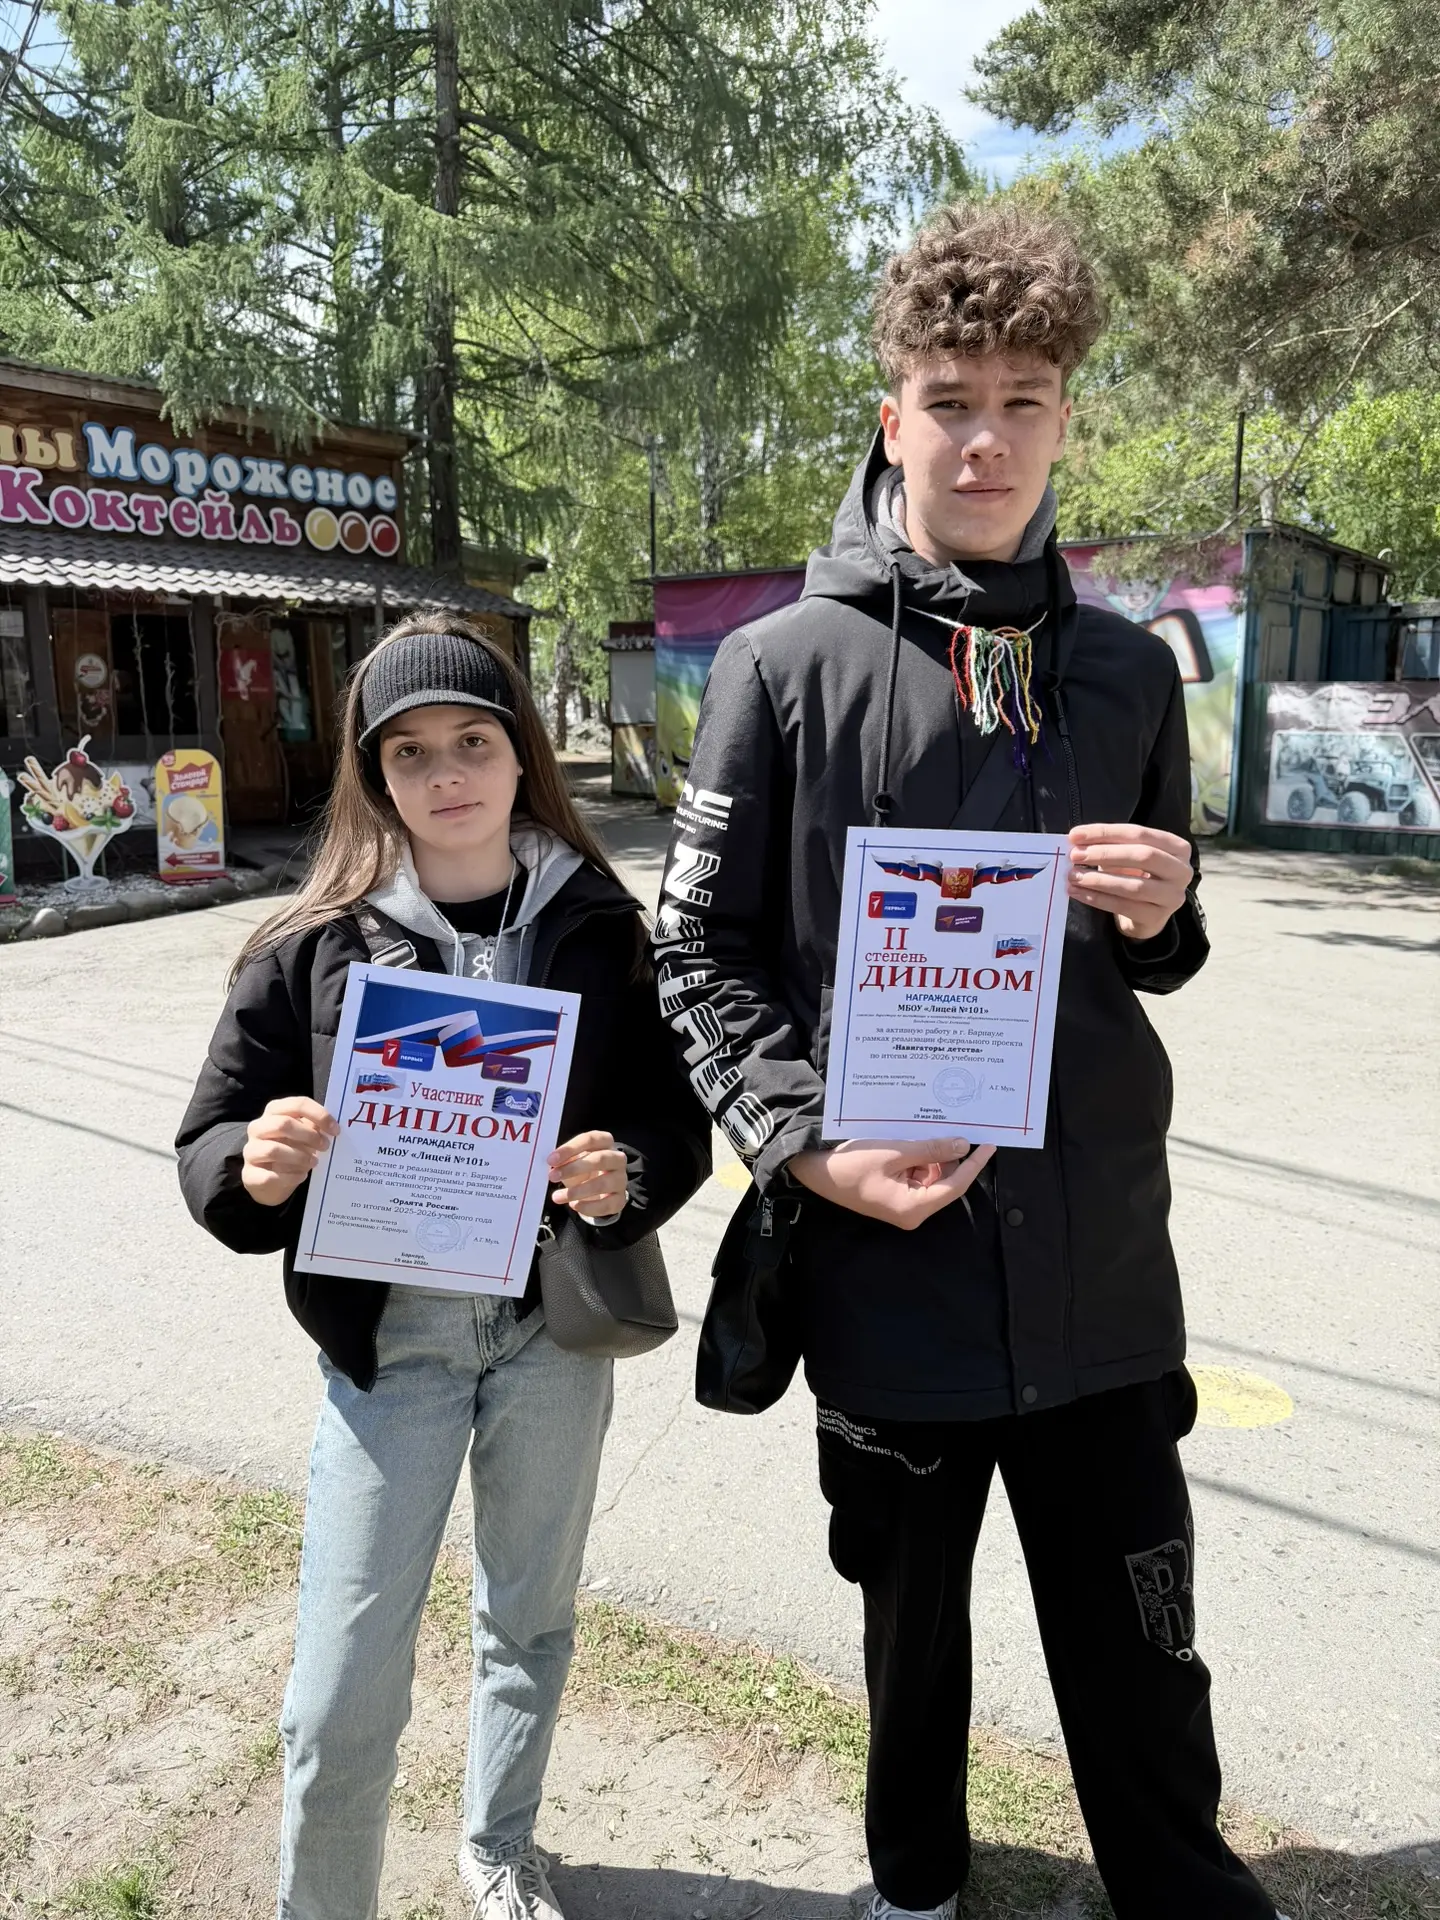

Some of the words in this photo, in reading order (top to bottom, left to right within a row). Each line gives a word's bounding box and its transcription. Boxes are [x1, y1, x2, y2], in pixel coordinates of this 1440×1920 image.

[82, 421, 398, 511] Мороженое
[0, 465, 302, 547] Коктейль
[883, 926, 910, 950] II
[865, 952, 928, 963] степень
[859, 965, 1035, 992] ДИПЛОМ
[905, 993, 978, 1004] НАГРАЖДАЕТСЯ
[897, 1004, 922, 1012] МБОУ
[958, 1006, 989, 1014] №101»
[937, 1037, 990, 1045] федерального
[991, 1040, 1023, 1048] проекта
[967, 1029, 1004, 1037] Барнауле
[909, 1053, 950, 1061] 2025-2026
[410, 1081, 484, 1107] Участник
[348, 1100, 534, 1144] ДИПЛОМ
[398, 1134, 475, 1151] НАГРАЖДАЕТСЯ
[377, 1146, 409, 1157] МБОУ
[410, 1151, 452, 1163] «Лицей
[453, 1155, 490, 1167] №101»
[355, 1166, 417, 1181] Всероссийской
[418, 1175, 464, 1185] программы
[466, 1181, 503, 1190] развития
[364, 1160, 398, 1169] участие
[405, 1165, 453, 1176] реализации
[470, 1172, 508, 1182] Барнауле
[335, 1174, 383, 1185] социальной
[385, 1182, 432, 1191] активности
[434, 1186, 474, 1196] учащихся
[475, 1191, 518, 1201] начальных
[411, 1192, 442, 1201] классов
[363, 1203, 392, 1212] итогам
[394, 1206, 437, 1218] 2025-2026
[437, 1212, 473, 1222] учебного
[852, 1440, 892, 1456] MAKING
